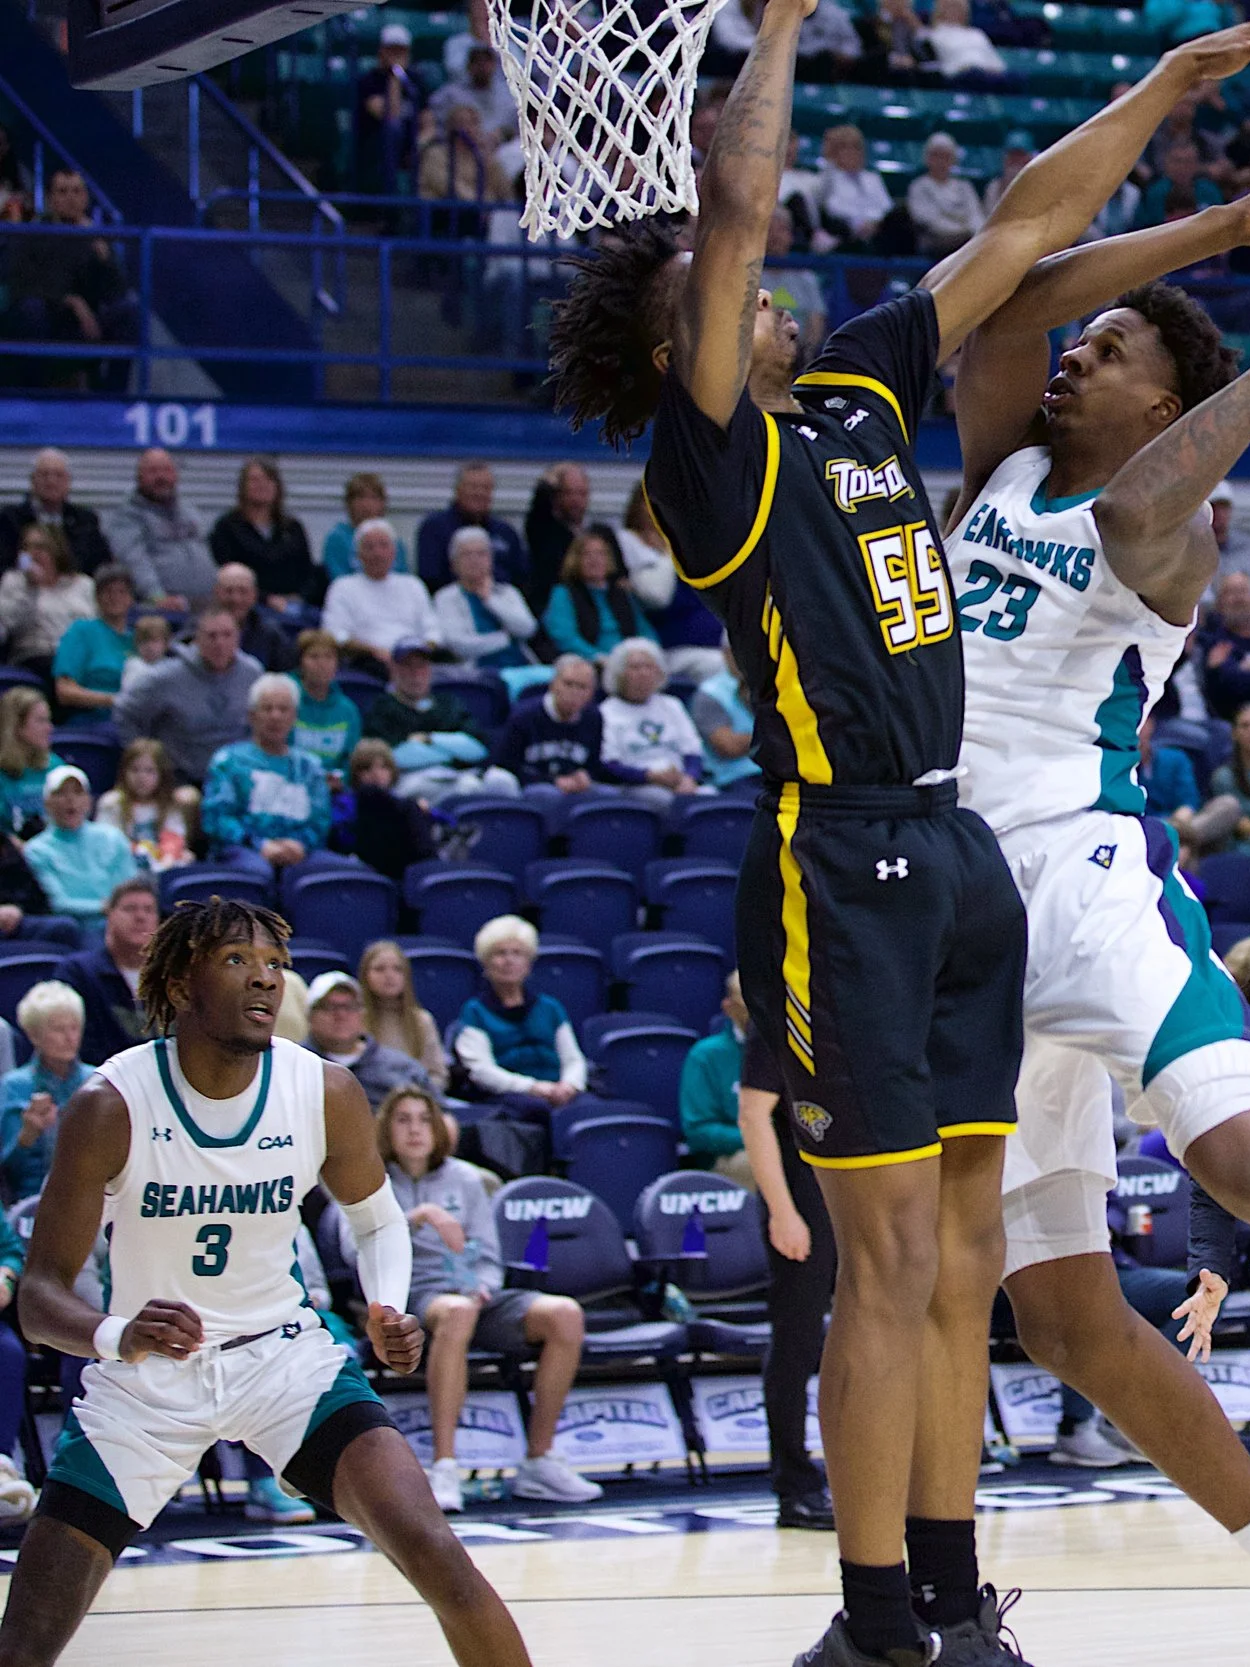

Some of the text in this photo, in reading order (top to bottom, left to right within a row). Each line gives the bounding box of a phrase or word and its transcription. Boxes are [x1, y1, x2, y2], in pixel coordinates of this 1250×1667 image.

[123, 402, 217, 447] 101
[857, 520, 954, 655] 55
[957, 560, 1041, 641] 23
[258, 1135, 294, 1150] CAA
[140, 1175, 294, 1218] SEAHAWKS
[659, 1189, 748, 1214] UNCW
[1117, 1171, 1181, 1197] NCW
[504, 1196, 595, 1221] UNCW
[192, 1223, 232, 1276] 3
